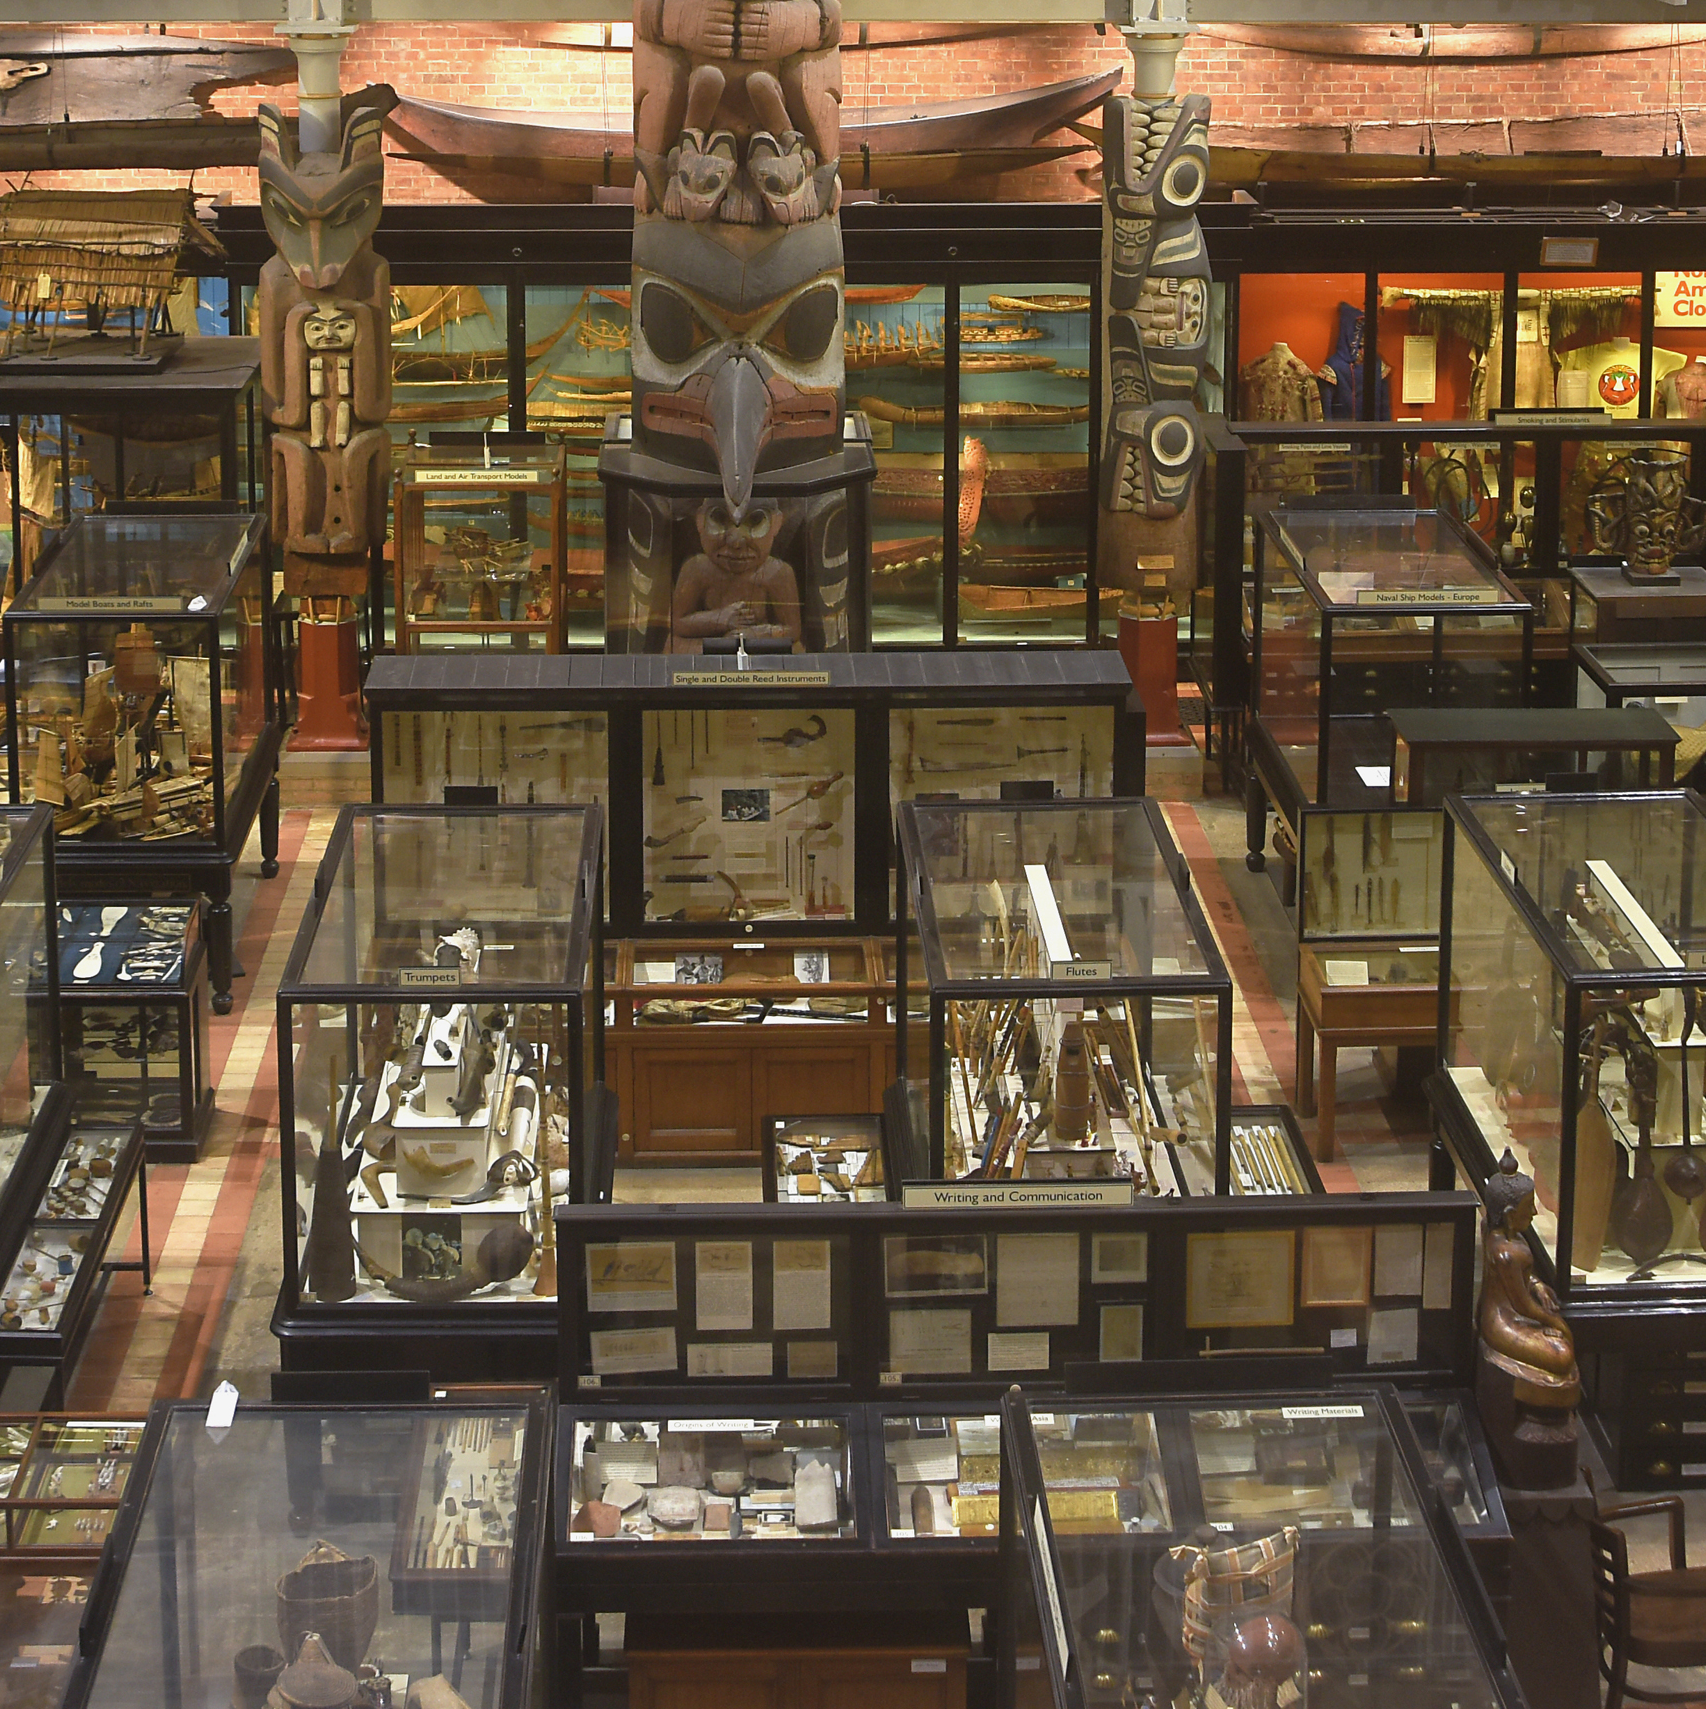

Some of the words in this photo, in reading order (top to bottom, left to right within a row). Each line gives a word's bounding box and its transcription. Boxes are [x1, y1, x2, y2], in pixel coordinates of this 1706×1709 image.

[1518, 416, 1543, 425] Smoking
[471, 473, 502, 481] Transport
[1400, 594, 1416, 603] Ship
[1453, 593, 1479, 602] Europe
[66, 600, 90, 608] Model
[92, 600, 114, 608] Boats
[117, 600, 130, 608] and
[133, 600, 153, 608] Rafts
[676, 675, 699, 685] Single
[752, 674, 774, 682] Reed
[776, 674, 826, 682] Instruments
[1066, 967, 1097, 976] Flutes
[404, 972, 456, 984] Trumpets
[934, 1192, 979, 1205] Writing
[983, 1191, 1005, 1202] and
[1009, 1190, 1103, 1202] Communication
[1287, 1408, 1319, 1416] Writing
